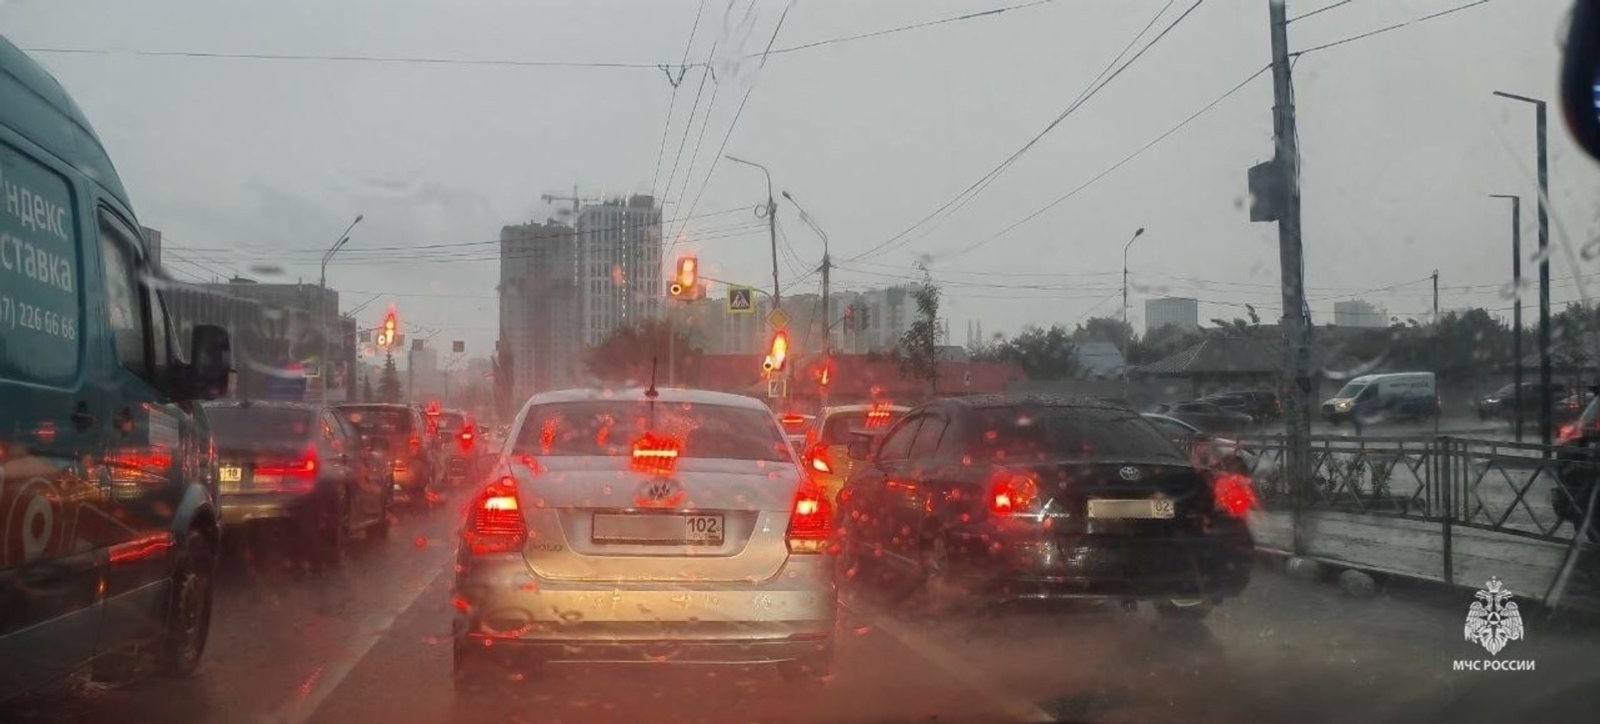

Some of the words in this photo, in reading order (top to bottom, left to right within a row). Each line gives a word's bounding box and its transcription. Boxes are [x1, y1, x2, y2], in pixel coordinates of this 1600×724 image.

[0, 168, 68, 240] ндекс
[0, 233, 73, 293] ставка
[18, 302, 42, 331] 226
[44, 310, 59, 335] 66
[61, 316, 75, 341] 66
[686, 517, 717, 533] 102
